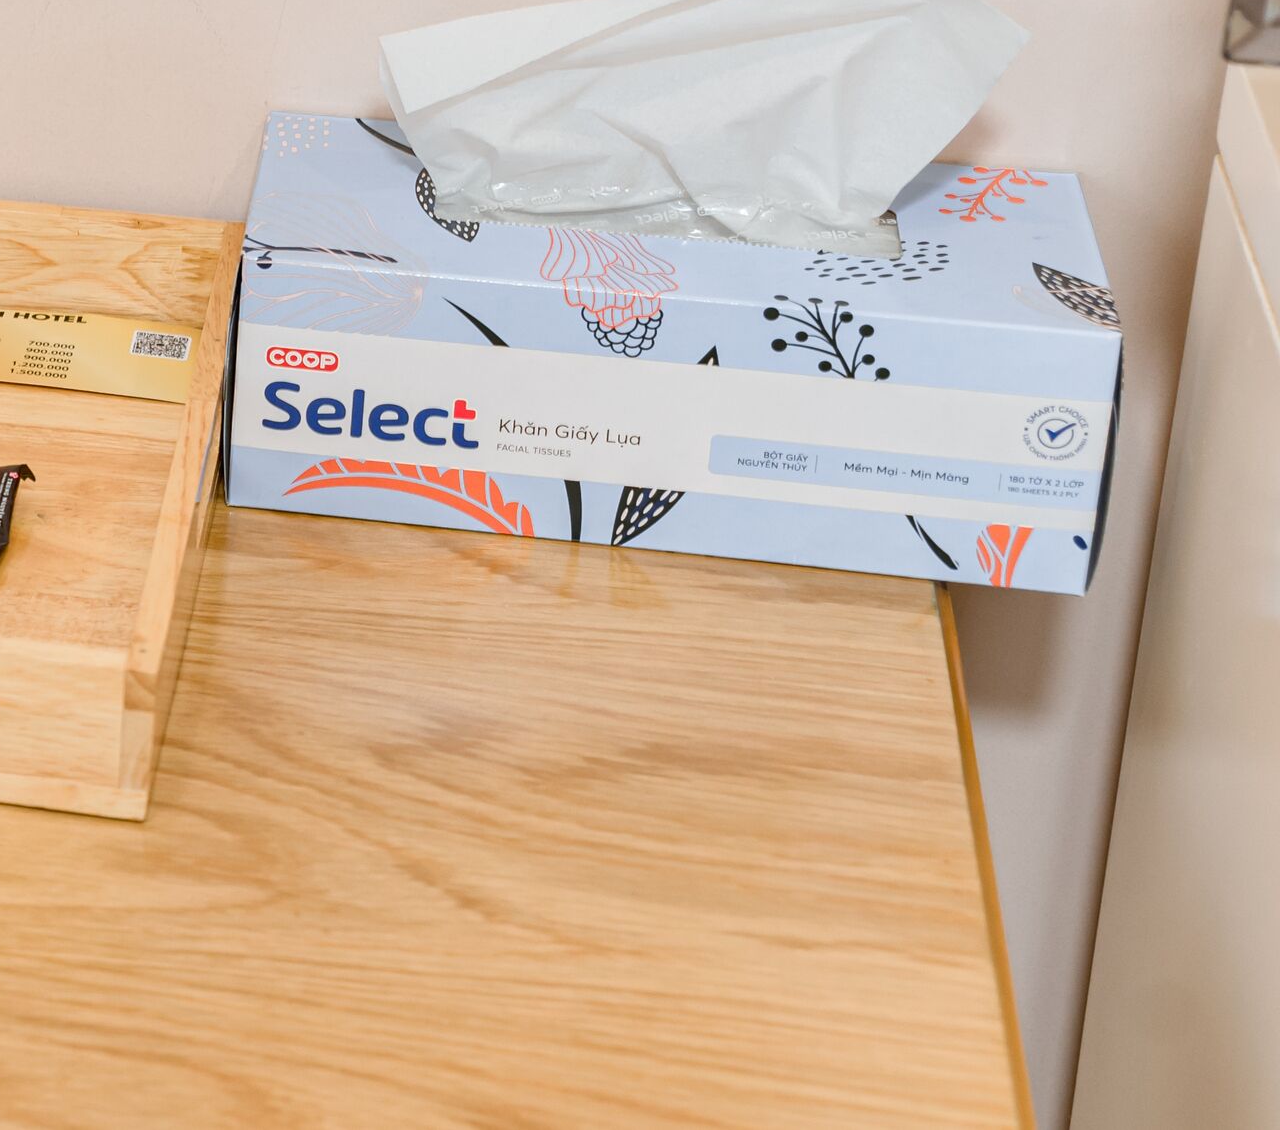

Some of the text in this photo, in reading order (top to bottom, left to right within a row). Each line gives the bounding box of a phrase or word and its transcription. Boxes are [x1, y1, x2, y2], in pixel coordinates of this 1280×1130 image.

[634, 209, 691, 226] Select
[13, 312, 88, 324] HOTEL
[26, 347, 74, 357] 900.000
[28, 341, 76, 350] 700.000
[23, 354, 72, 365] 900.000
[268, 348, 337, 369] COOP
[12, 360, 70, 372] 1.200.000
[10, 368, 67, 379] 1.500.000
[261, 381, 480, 450] Select
[1026, 405, 1089, 429] SMART CHOICE
[498, 418, 641, 448] Khăn Giấy Lụa
[496, 443, 572, 458] FACIAL TISSUES
[763, 450, 809, 463] BỘT GIẤY
[737, 457, 779, 470] NGUYÊN
[844, 462, 873, 473] Mềm
[876, 465, 898, 478] Mại
[910, 469, 932, 482] Mịn
[935, 471, 970, 485] Màng
[1009, 475, 1026, 484] 180
[1022, 487, 1050, 496] SHEETS
